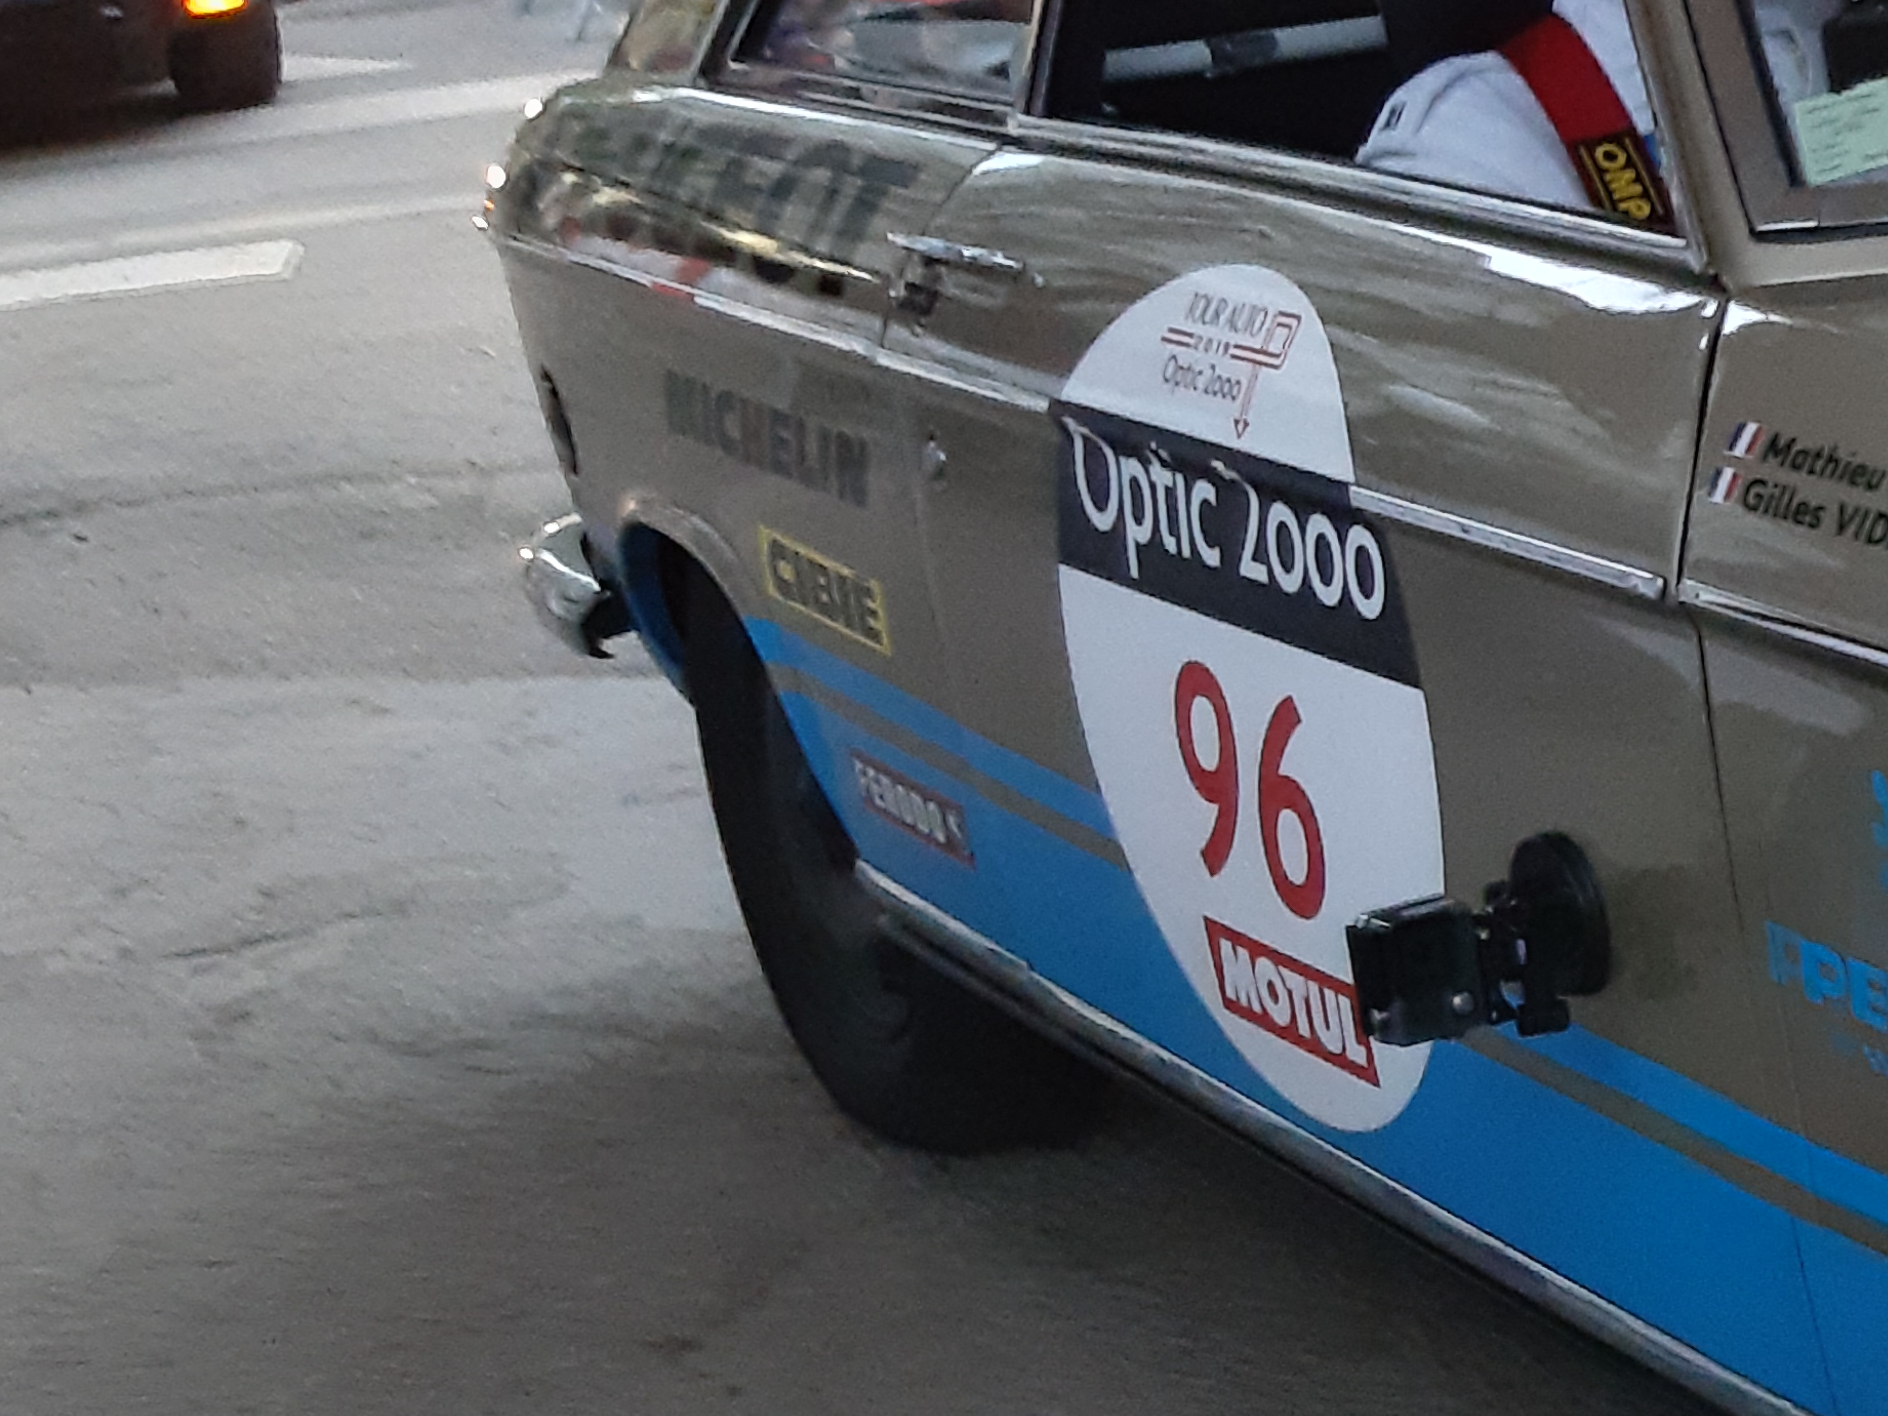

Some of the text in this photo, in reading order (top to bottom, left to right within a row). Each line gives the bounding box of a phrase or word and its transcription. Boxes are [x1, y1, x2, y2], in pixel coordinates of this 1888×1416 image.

[1595, 142, 1652, 221] OMP
[1203, 363, 1242, 402] 2000
[1763, 432, 1887, 492] Mathieu
[1070, 418, 1387, 620] Optic 2000
[1741, 478, 1826, 529] Gilles
[1174, 660, 1326, 921] 96
[1217, 936, 1369, 1068] MOTUL
